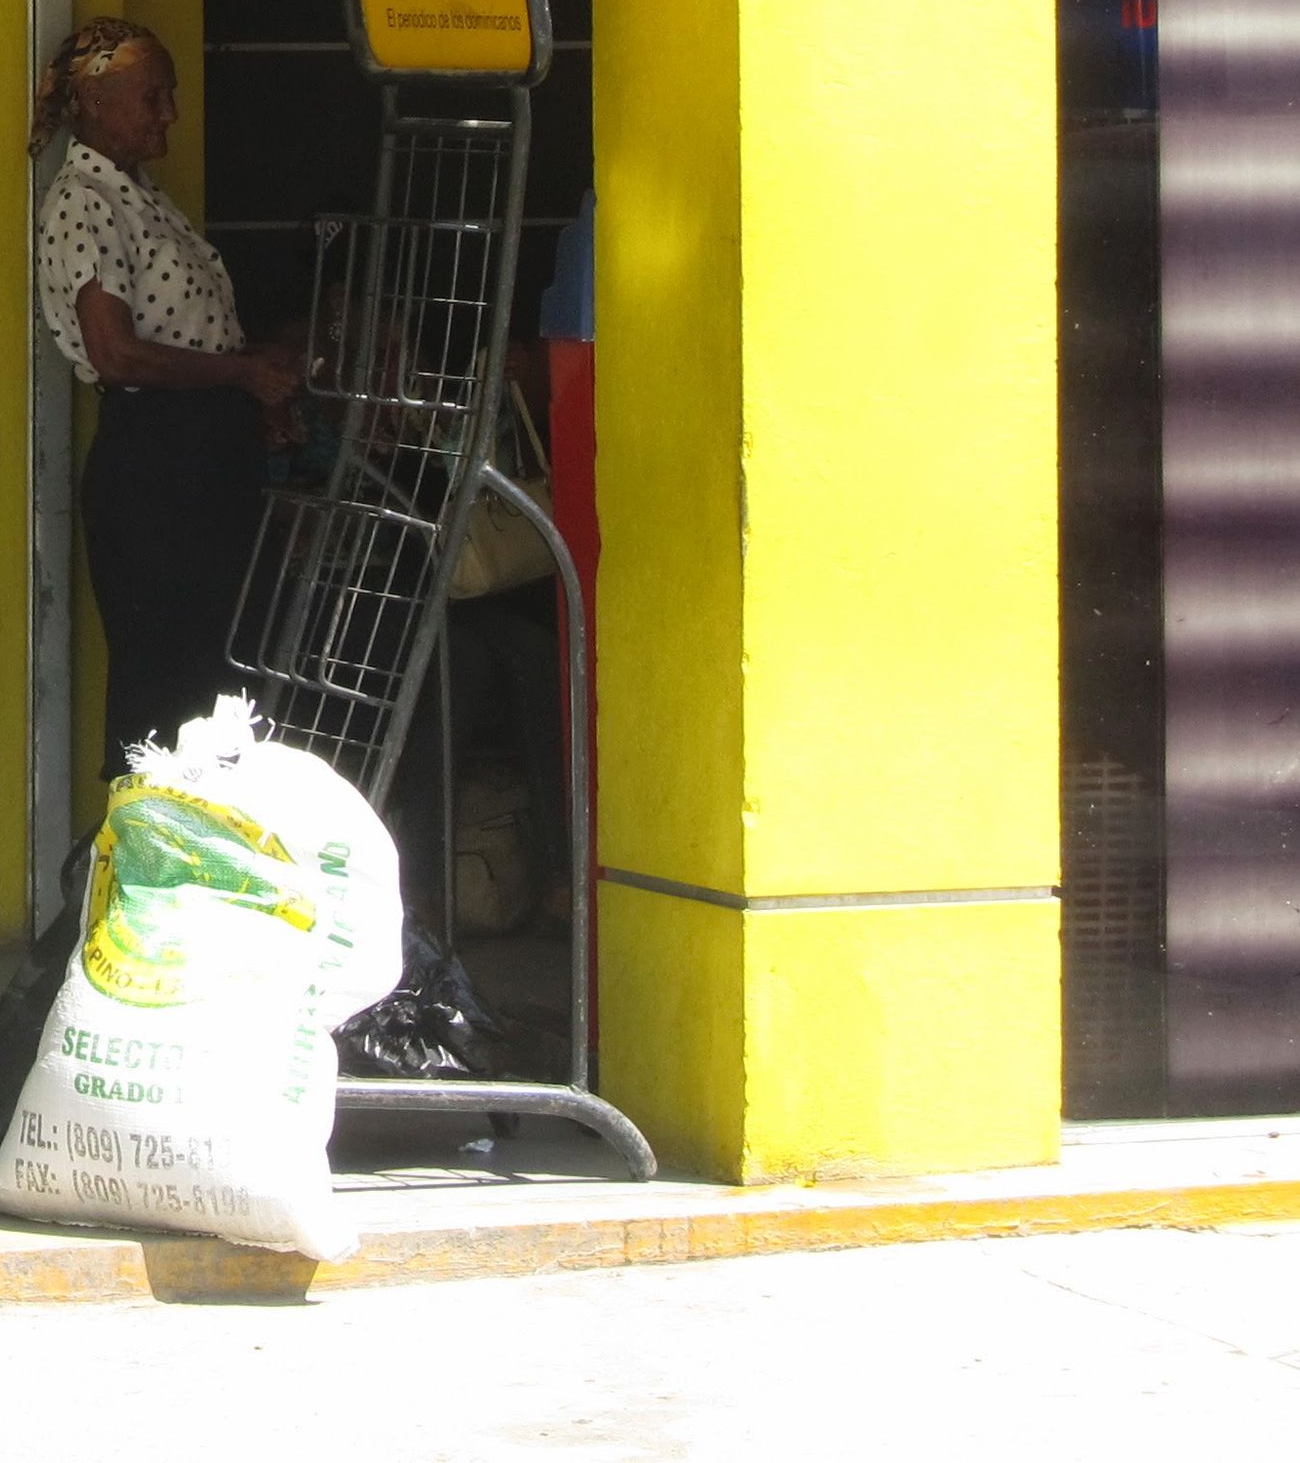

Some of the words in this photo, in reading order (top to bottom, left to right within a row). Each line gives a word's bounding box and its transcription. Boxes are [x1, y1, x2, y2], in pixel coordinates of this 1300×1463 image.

[88, 947, 133, 989] PINO
[73, 1073, 164, 1104] GRADO
[65, 1120, 123, 1172] (809)
[72, 1169, 133, 1210] (809)
